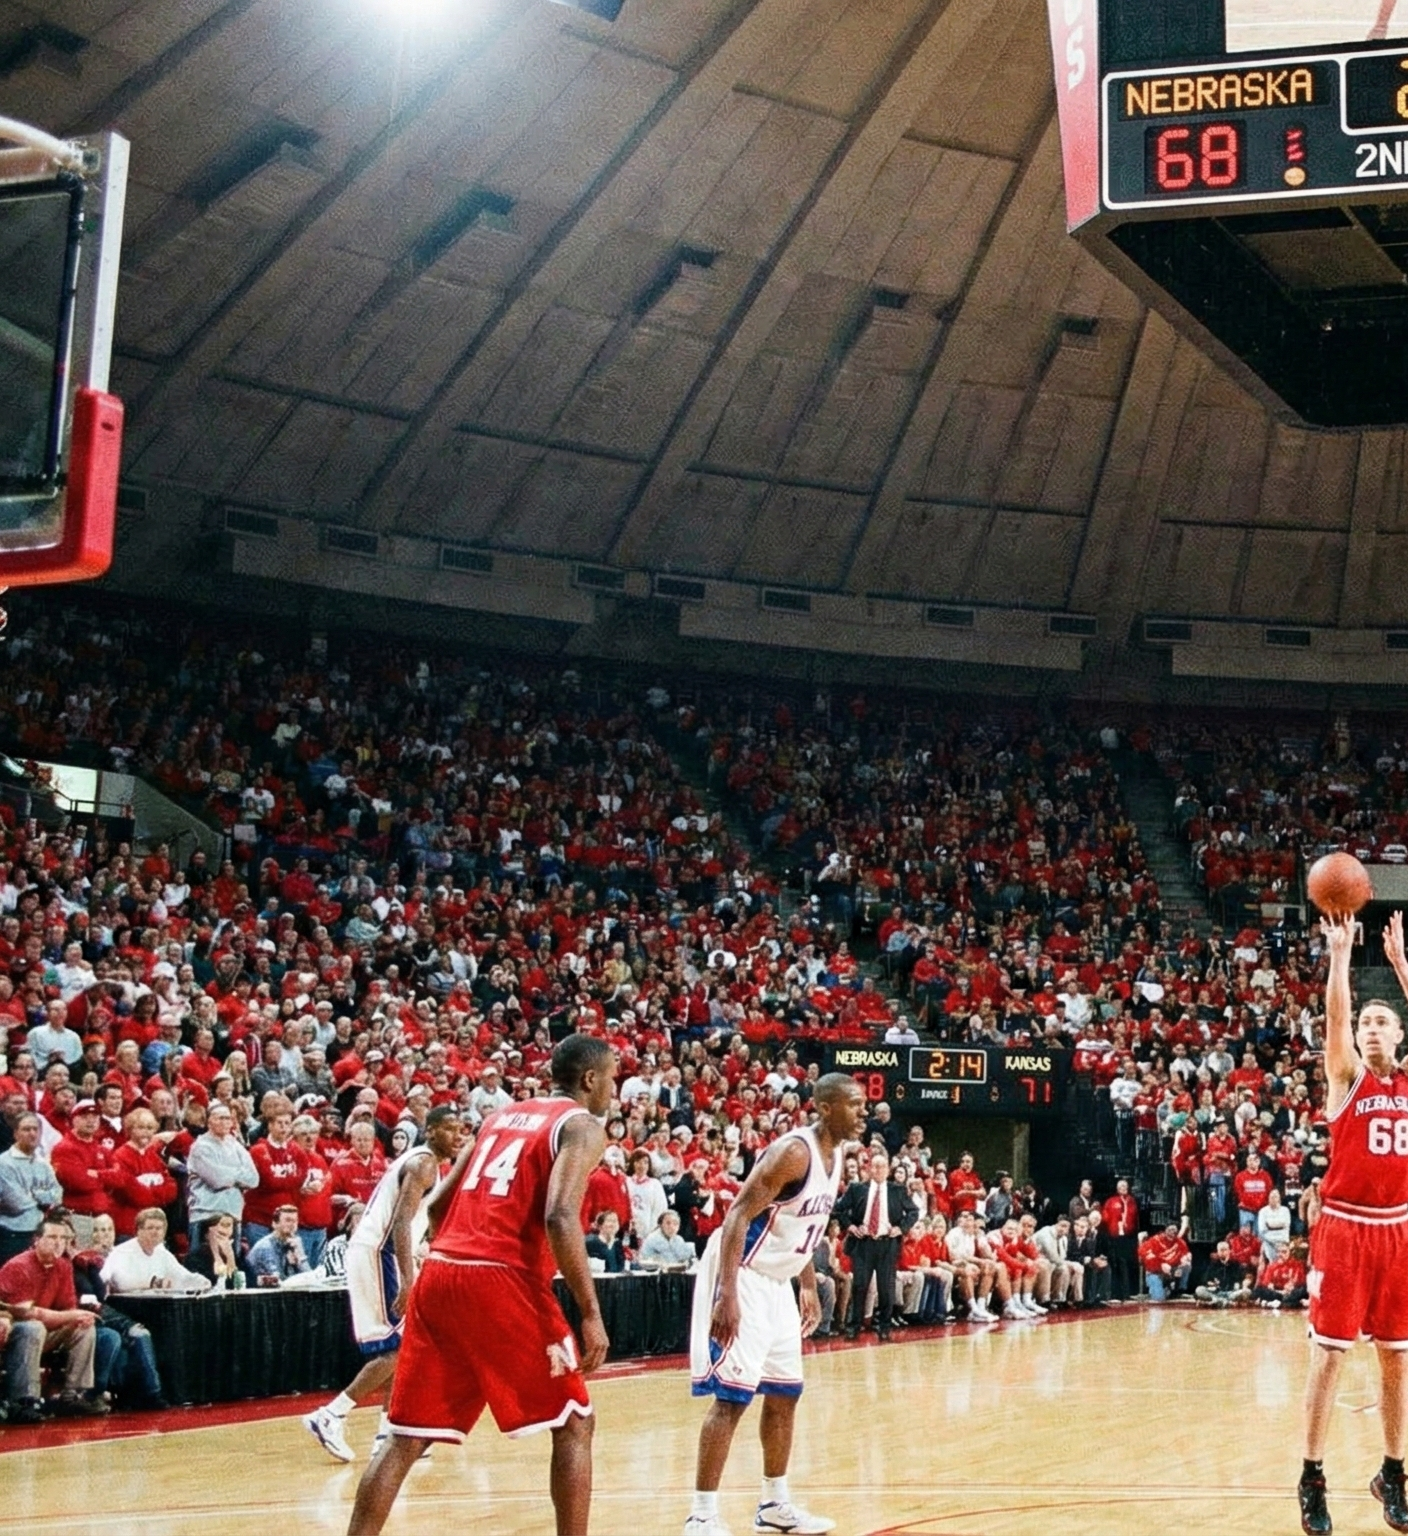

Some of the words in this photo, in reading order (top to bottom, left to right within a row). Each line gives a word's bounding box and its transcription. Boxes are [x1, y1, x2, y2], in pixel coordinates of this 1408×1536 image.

[1126, 69, 1313, 117] NEBRASKA
[1156, 125, 1238, 191] 68
[835, 1051, 899, 1067] NEBRASKA
[929, 1052, 982, 1079] 2:14
[1005, 1056, 1051, 1071] KANSAS
[1020, 1077, 1051, 1103] 71
[462, 1135, 527, 1197] 14
[546, 1334, 579, 1378] N
